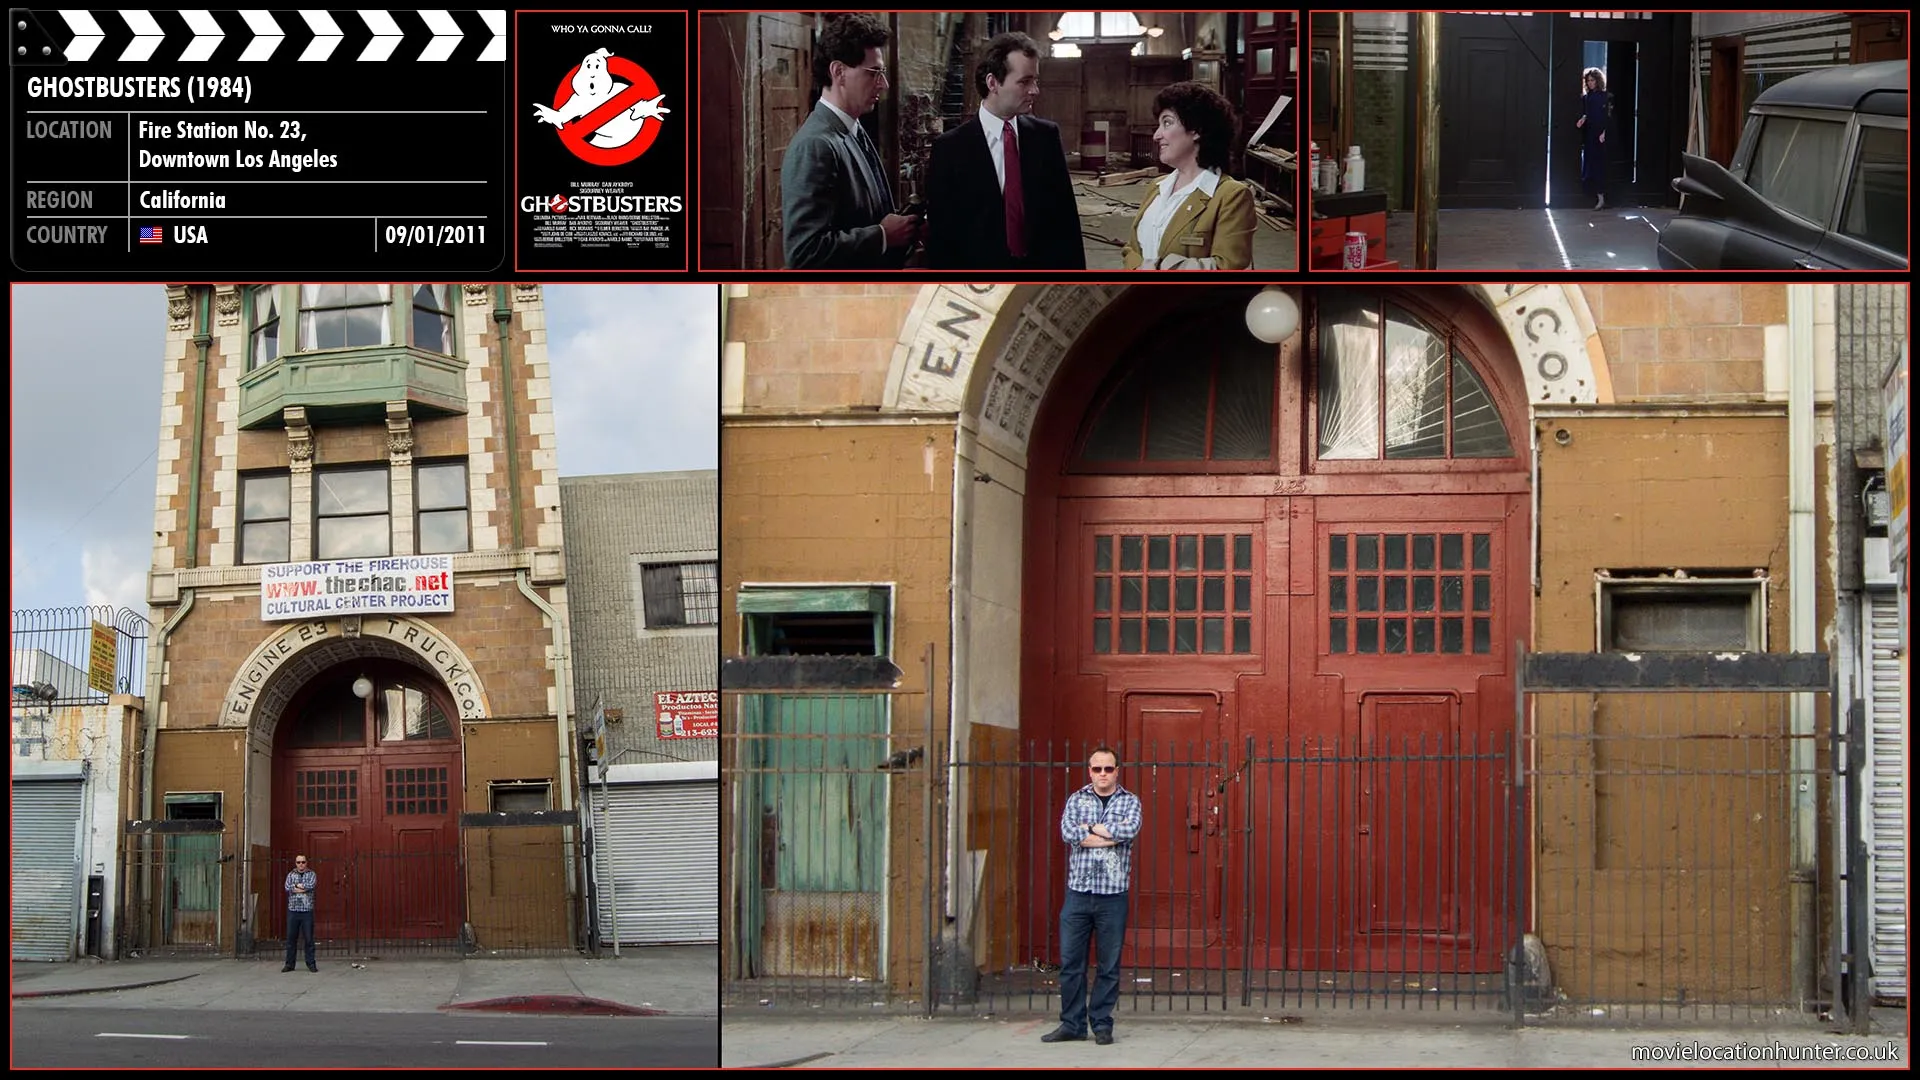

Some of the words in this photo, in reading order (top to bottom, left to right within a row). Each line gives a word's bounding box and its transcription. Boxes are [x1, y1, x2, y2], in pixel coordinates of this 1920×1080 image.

[551, 24, 575, 33] WHO
[577, 24, 589, 33] YA
[590, 24, 625, 33] GONNA
[627, 24, 653, 33] CALL?
[920, 284, 997, 378] EN
[268, 562, 331, 578] SUPPORT
[336, 561, 363, 574] THE
[369, 557, 448, 572] FIREHOUSE
[267, 601, 331, 615] CULTURAL
[335, 595, 387, 609] CENTER
[391, 593, 449, 608] PROJECT
[232, 638, 292, 714] ENGINE
[298, 620, 328, 642] 23
[387, 619, 463, 678] TRUCK
[658, 694, 674, 704] EL
